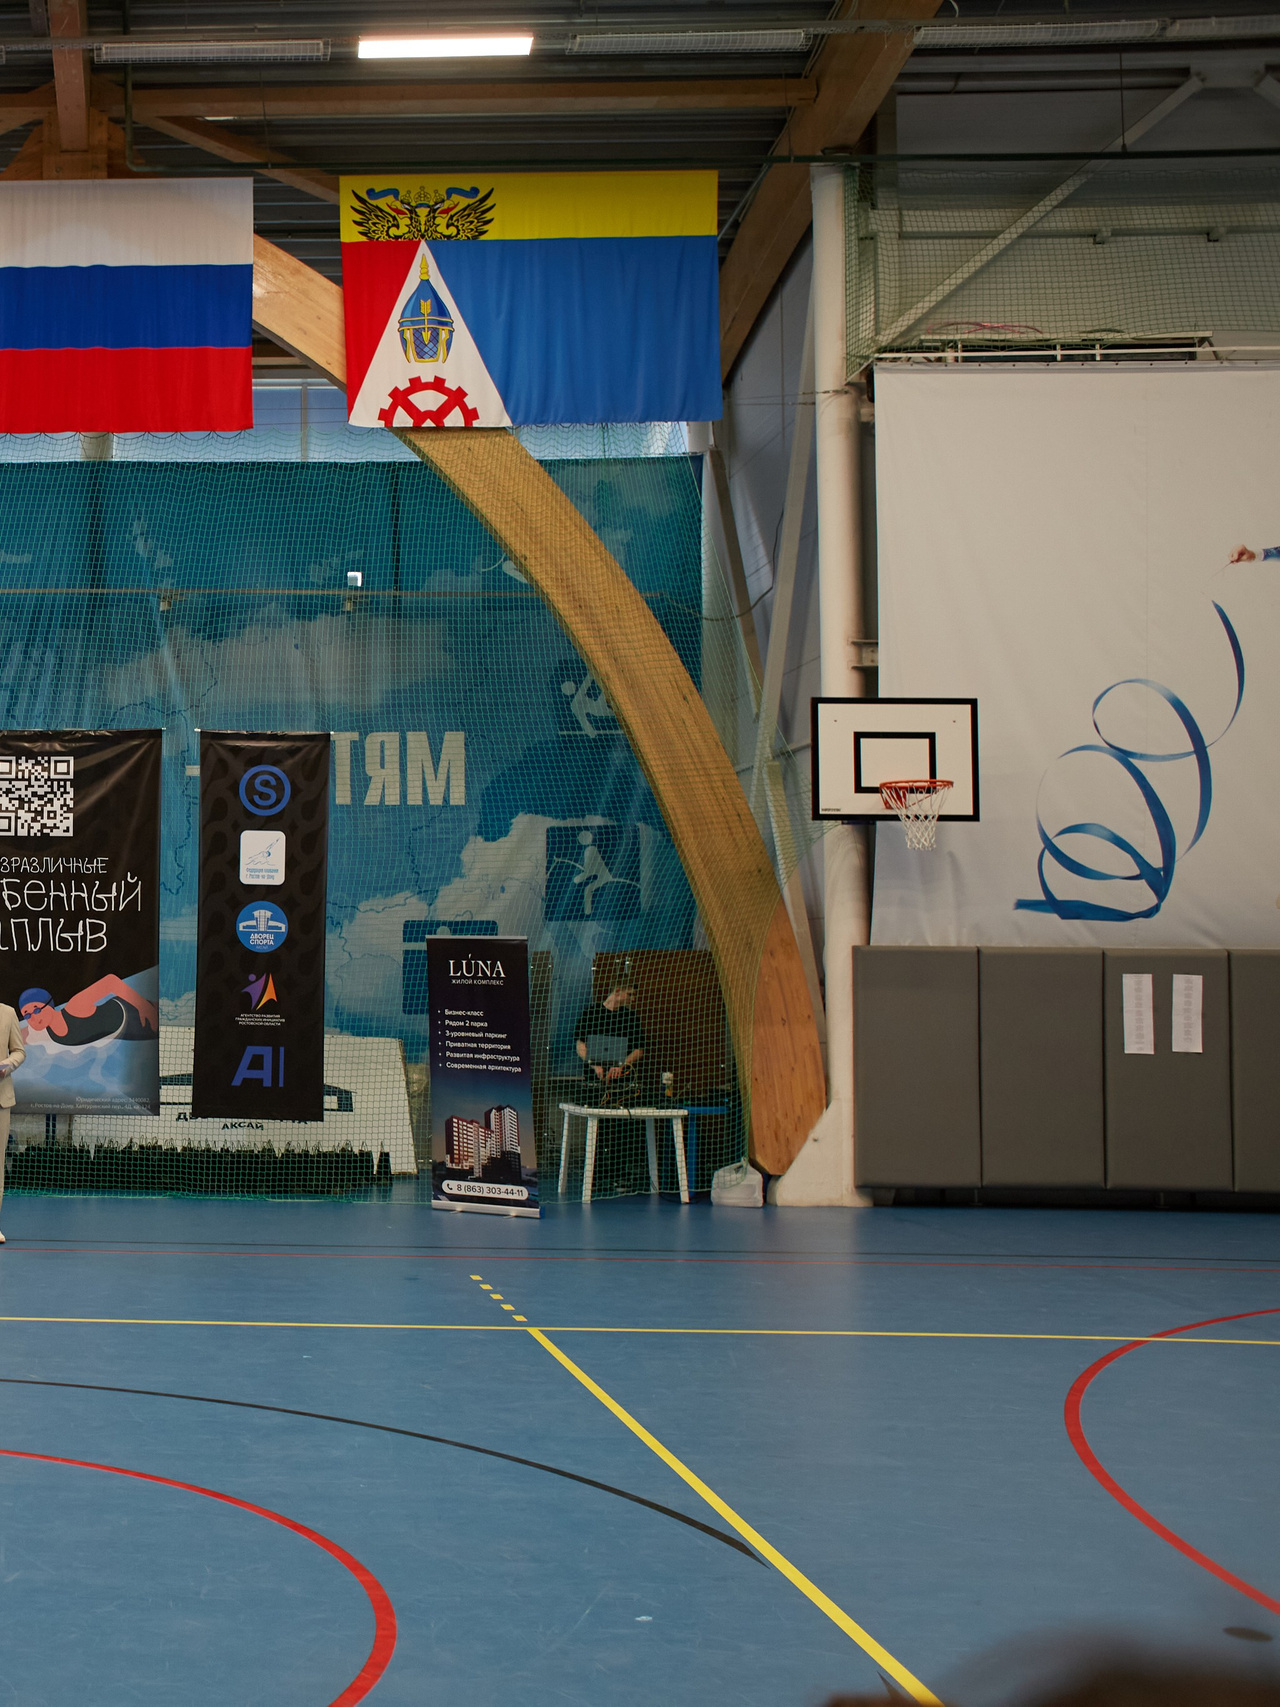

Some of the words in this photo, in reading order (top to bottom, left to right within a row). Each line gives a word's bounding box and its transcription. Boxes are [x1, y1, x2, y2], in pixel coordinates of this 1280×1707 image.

[330, 731, 465, 805] ТЯМ
[474, 1053, 520, 1062] инфраструктура
[446, 1062, 487, 1070] Современная
[487, 1065, 522, 1073] архитектура
[221, 1121, 264, 1131] АКСАЙ
[463, 1185, 484, 1194] (863)
[486, 1186, 524, 1197] 303-44-11
